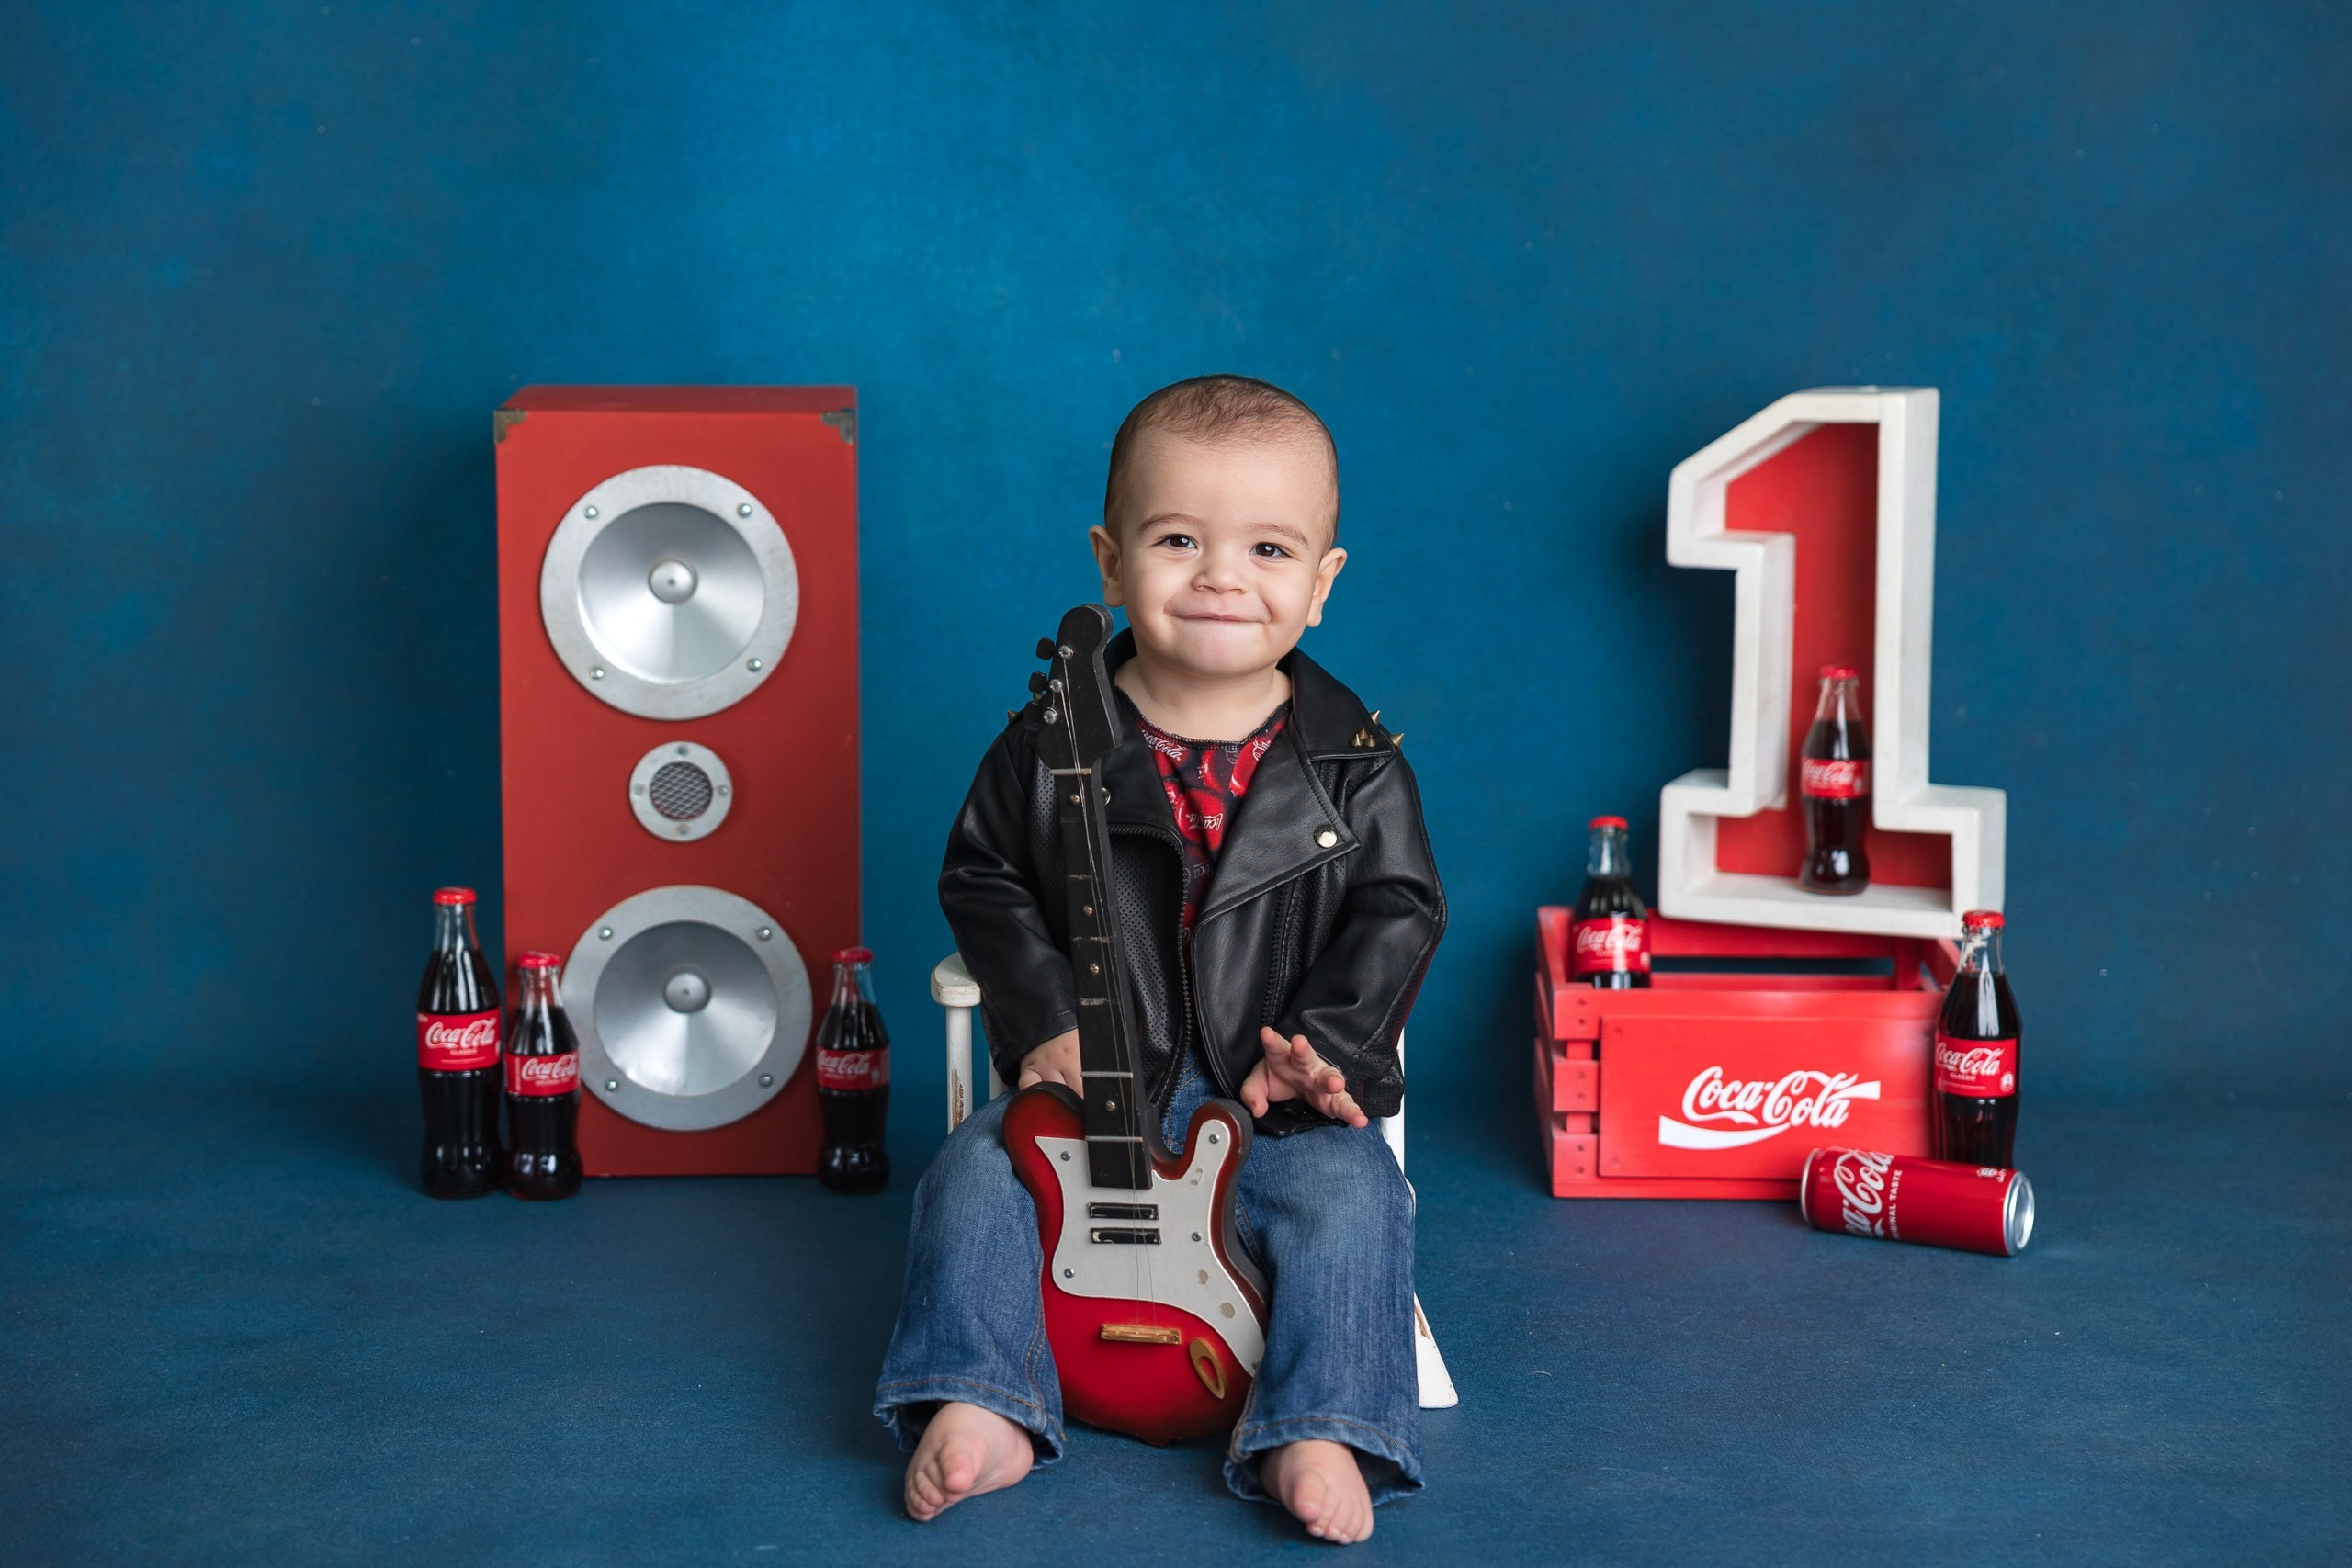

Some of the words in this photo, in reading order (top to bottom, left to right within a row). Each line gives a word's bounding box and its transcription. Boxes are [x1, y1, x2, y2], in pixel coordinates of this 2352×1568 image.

[1658, 387, 2007, 939] 1
[1141, 729, 1190, 761] oca-Cola
[425, 1017, 497, 1049] Coca-Cola
[1935, 1042, 2005, 1076] Coca-Cola
[1680, 1066, 1860, 1130] Coca-Cola
[1889, 1169, 1903, 1201] TASTE
